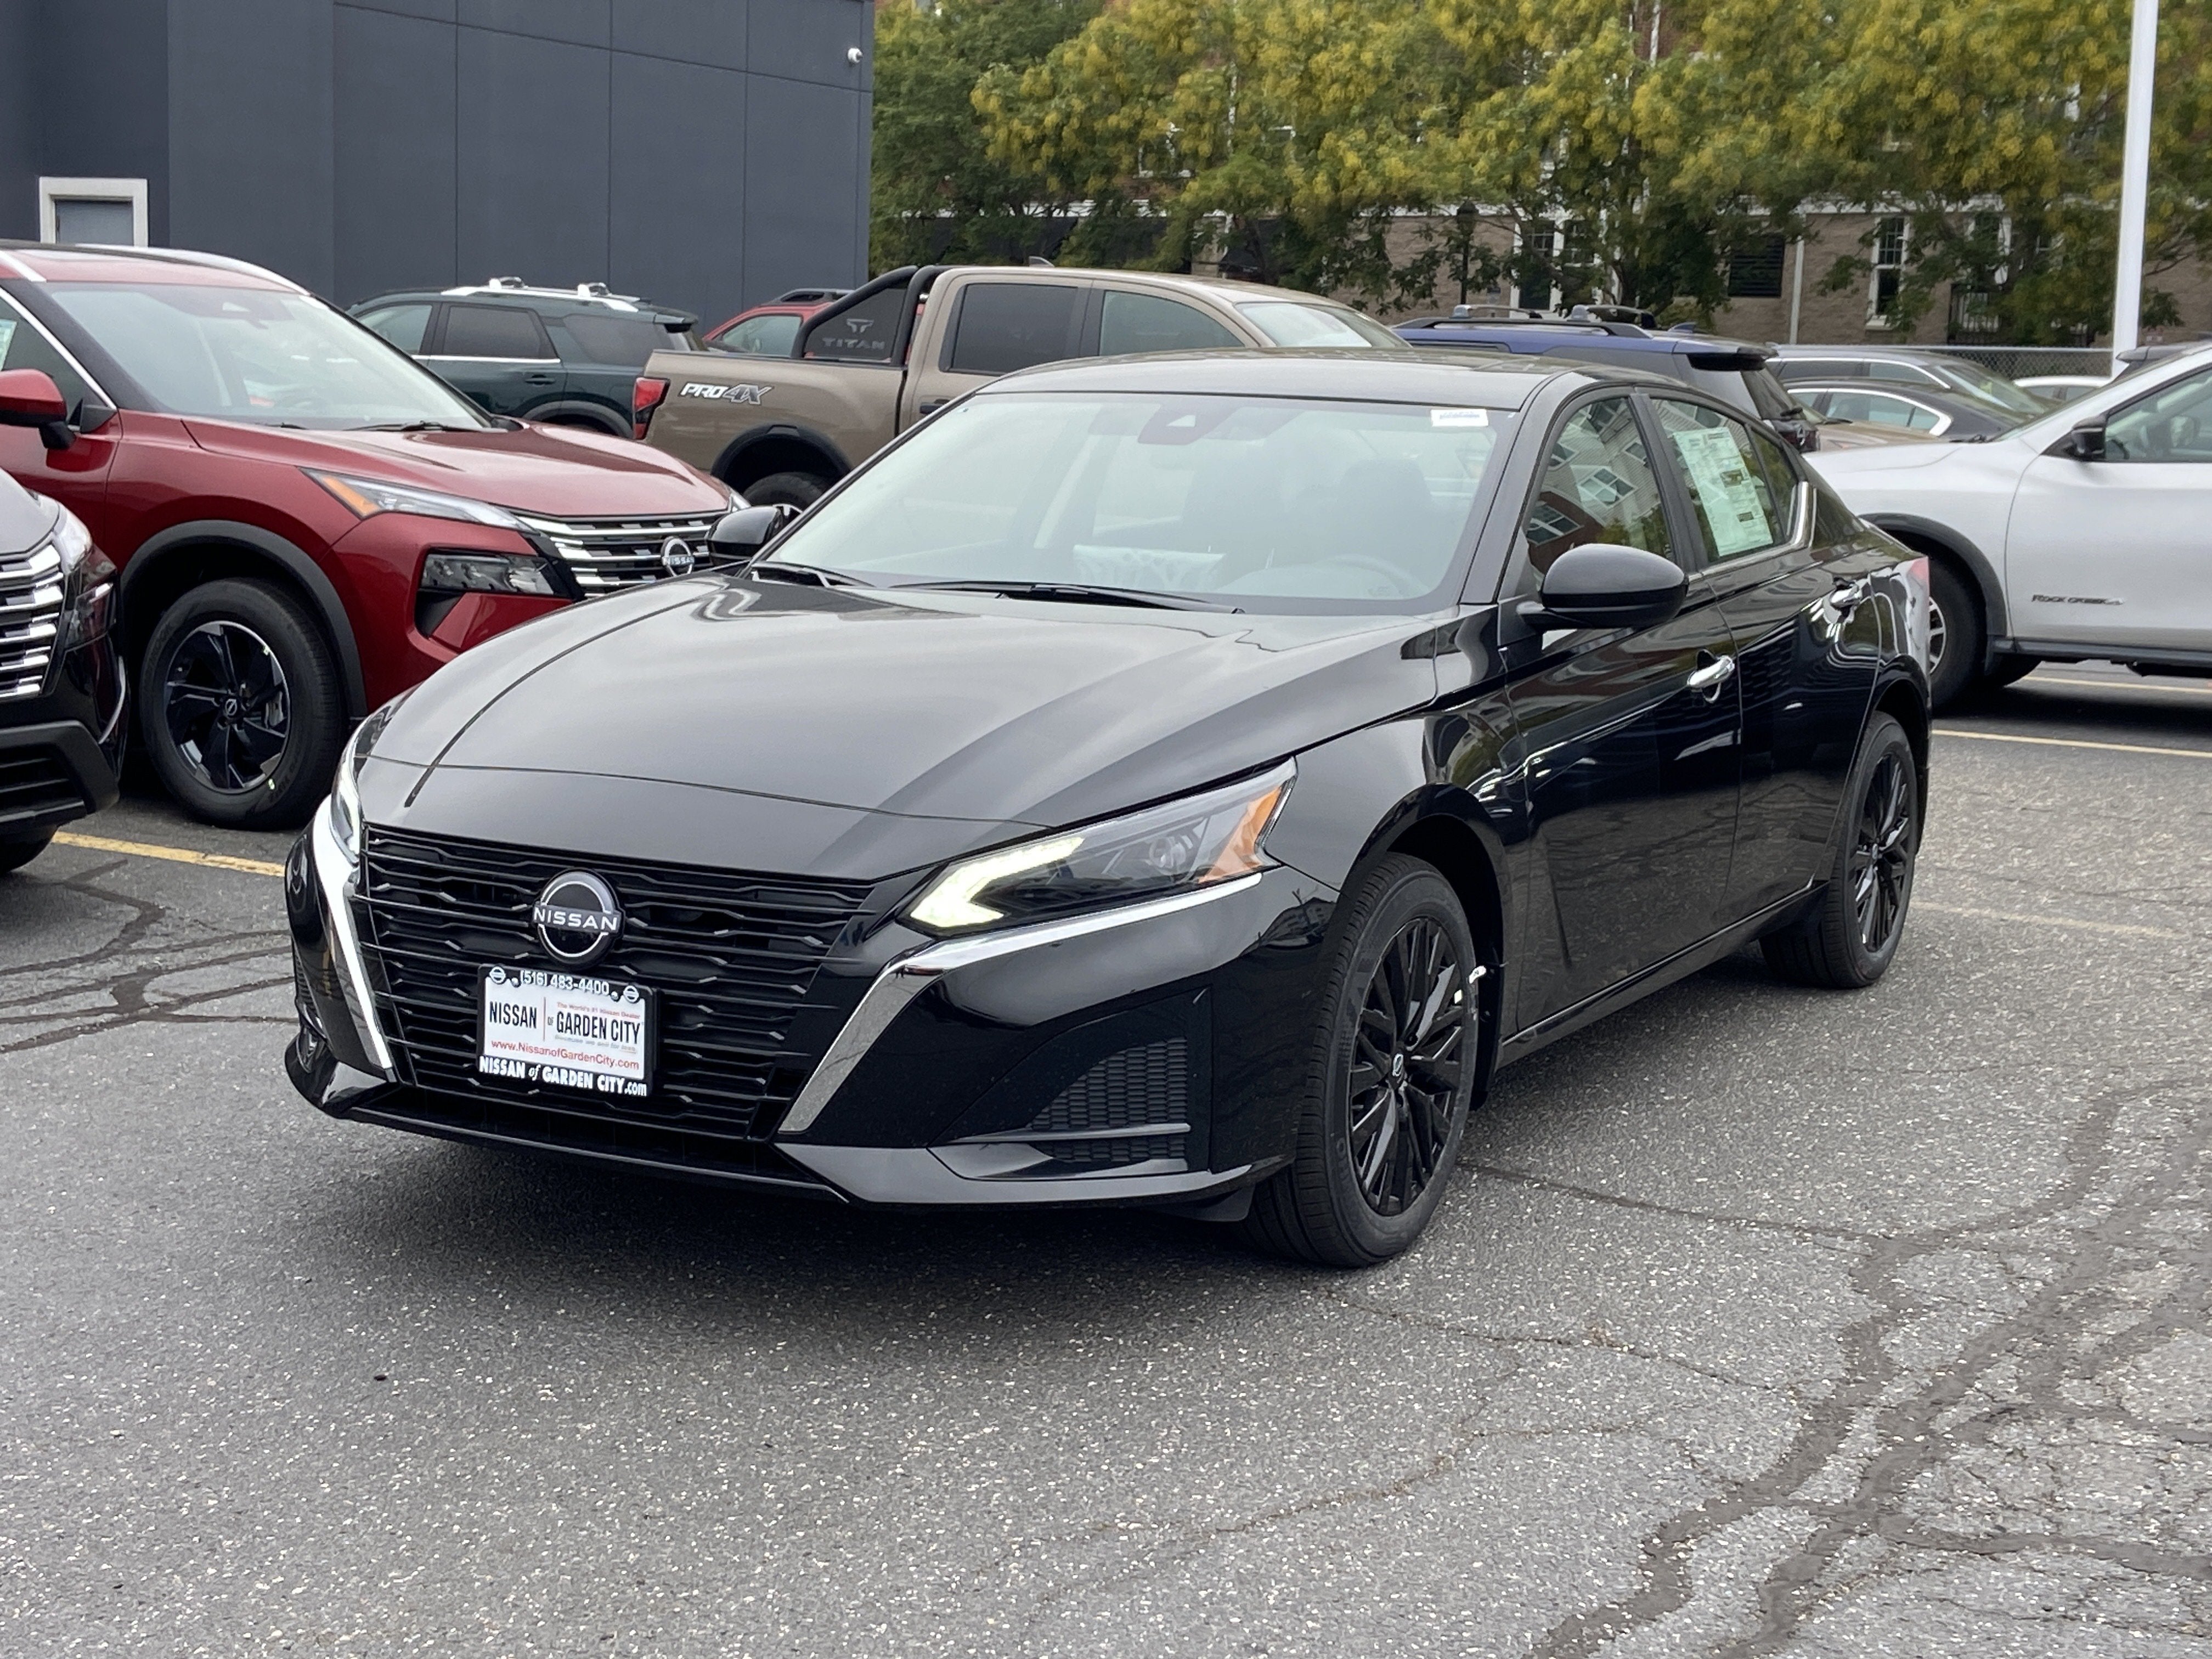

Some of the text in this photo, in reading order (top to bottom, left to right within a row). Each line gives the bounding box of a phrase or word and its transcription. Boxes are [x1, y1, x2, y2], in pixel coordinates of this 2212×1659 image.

[823, 337, 885, 350] TITAN
[662, 555, 695, 566] NISSAN
[533, 906, 618, 931] NISSAN
[520, 969, 610, 996] (516) 483-4400
[489, 1001, 537, 1029] NISSAN
[556, 1011, 607, 1040] GARDEN
[611, 1019, 640, 1045] CITY
[491, 1040, 640, 1070] www.NissanofGardenCity.com
[479, 1055, 647, 1097] NISSAN of GARDEN CITY.com
